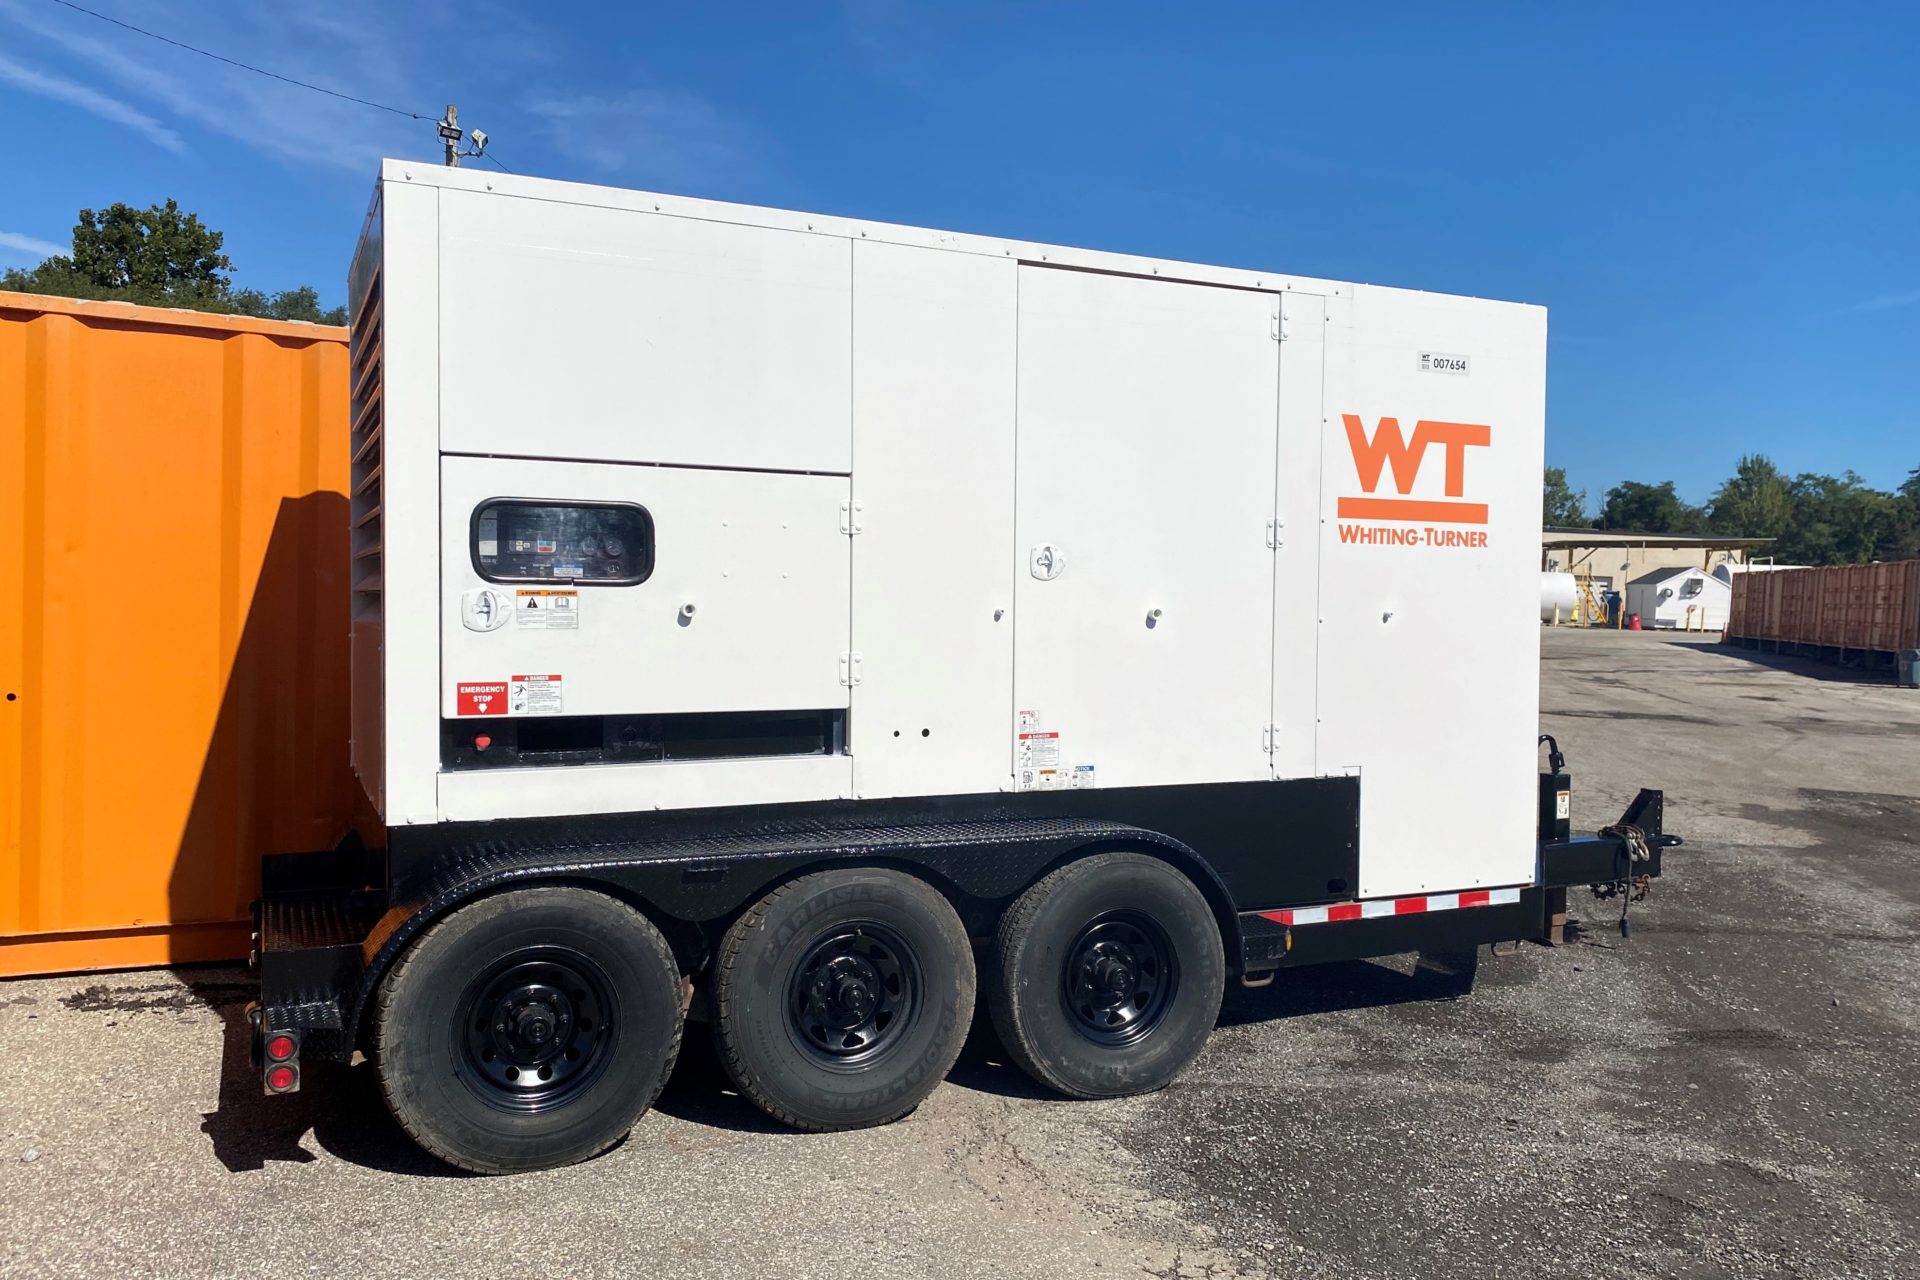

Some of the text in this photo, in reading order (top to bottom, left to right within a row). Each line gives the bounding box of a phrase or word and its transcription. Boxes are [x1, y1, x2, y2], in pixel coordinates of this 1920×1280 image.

[1433, 358, 1466, 371] 007654
[1341, 413, 1491, 497] WT
[460, 685, 505, 694] EMERGENCY
